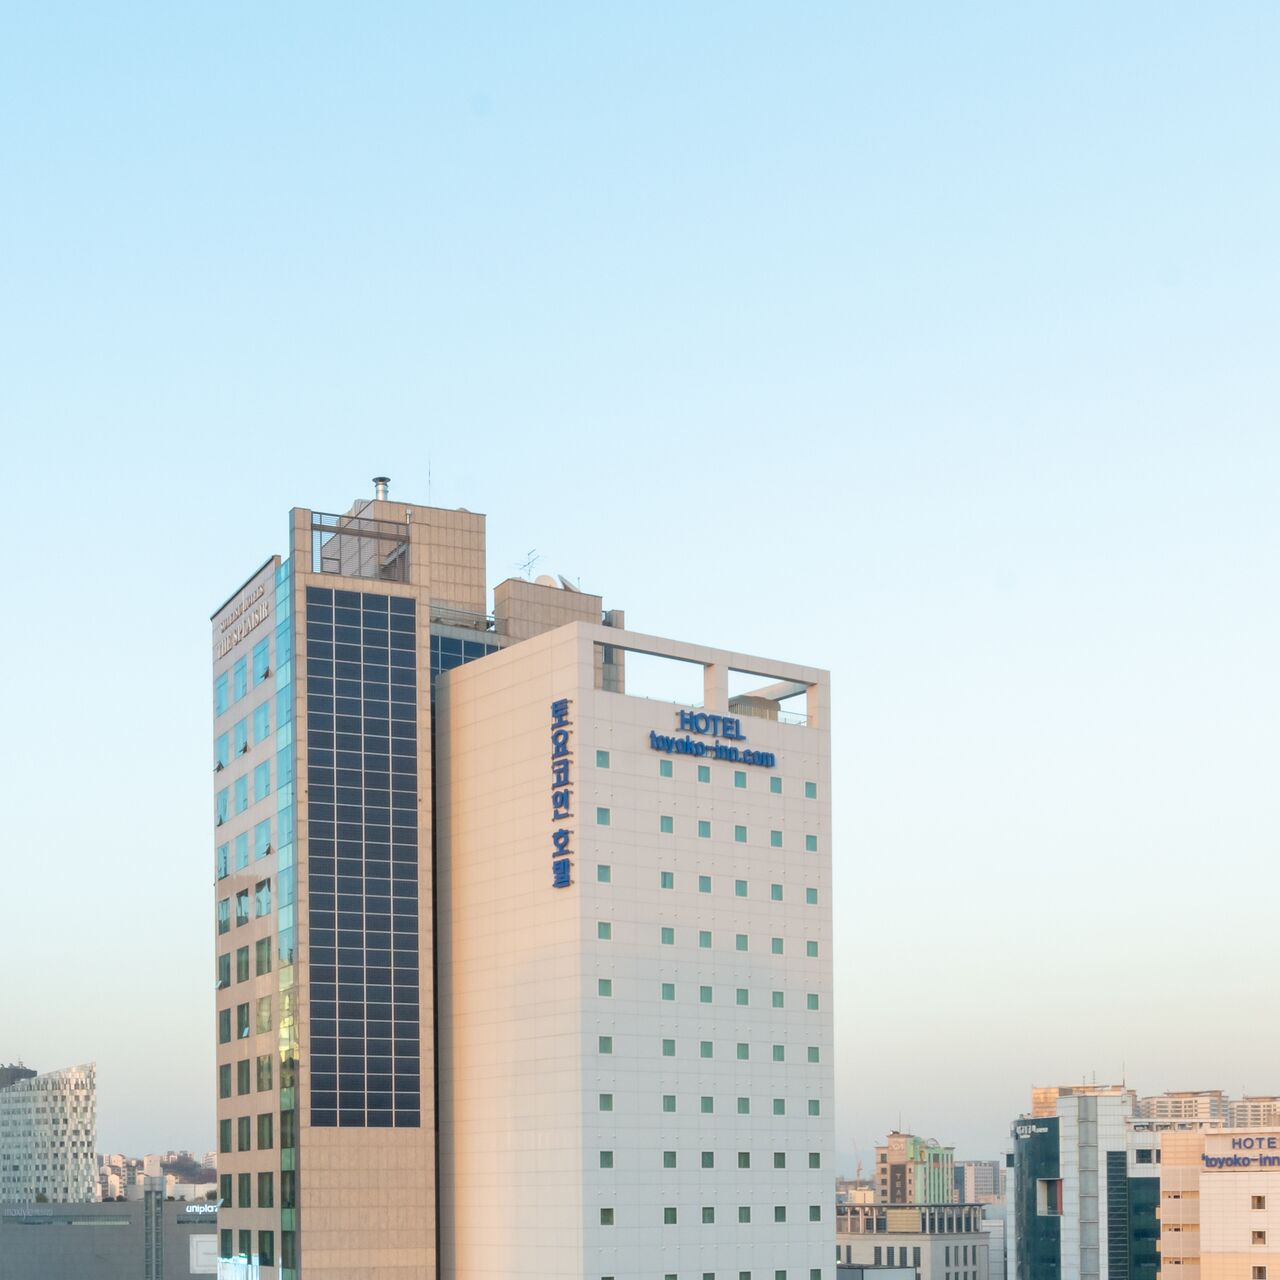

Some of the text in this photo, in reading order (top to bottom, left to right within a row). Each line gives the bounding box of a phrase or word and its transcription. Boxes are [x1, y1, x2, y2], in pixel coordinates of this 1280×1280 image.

[679, 709, 747, 741] HOTEL
[649, 729, 776, 768] toyoko-inn.com
[550, 698, 571, 889] 토요코인 호텔
